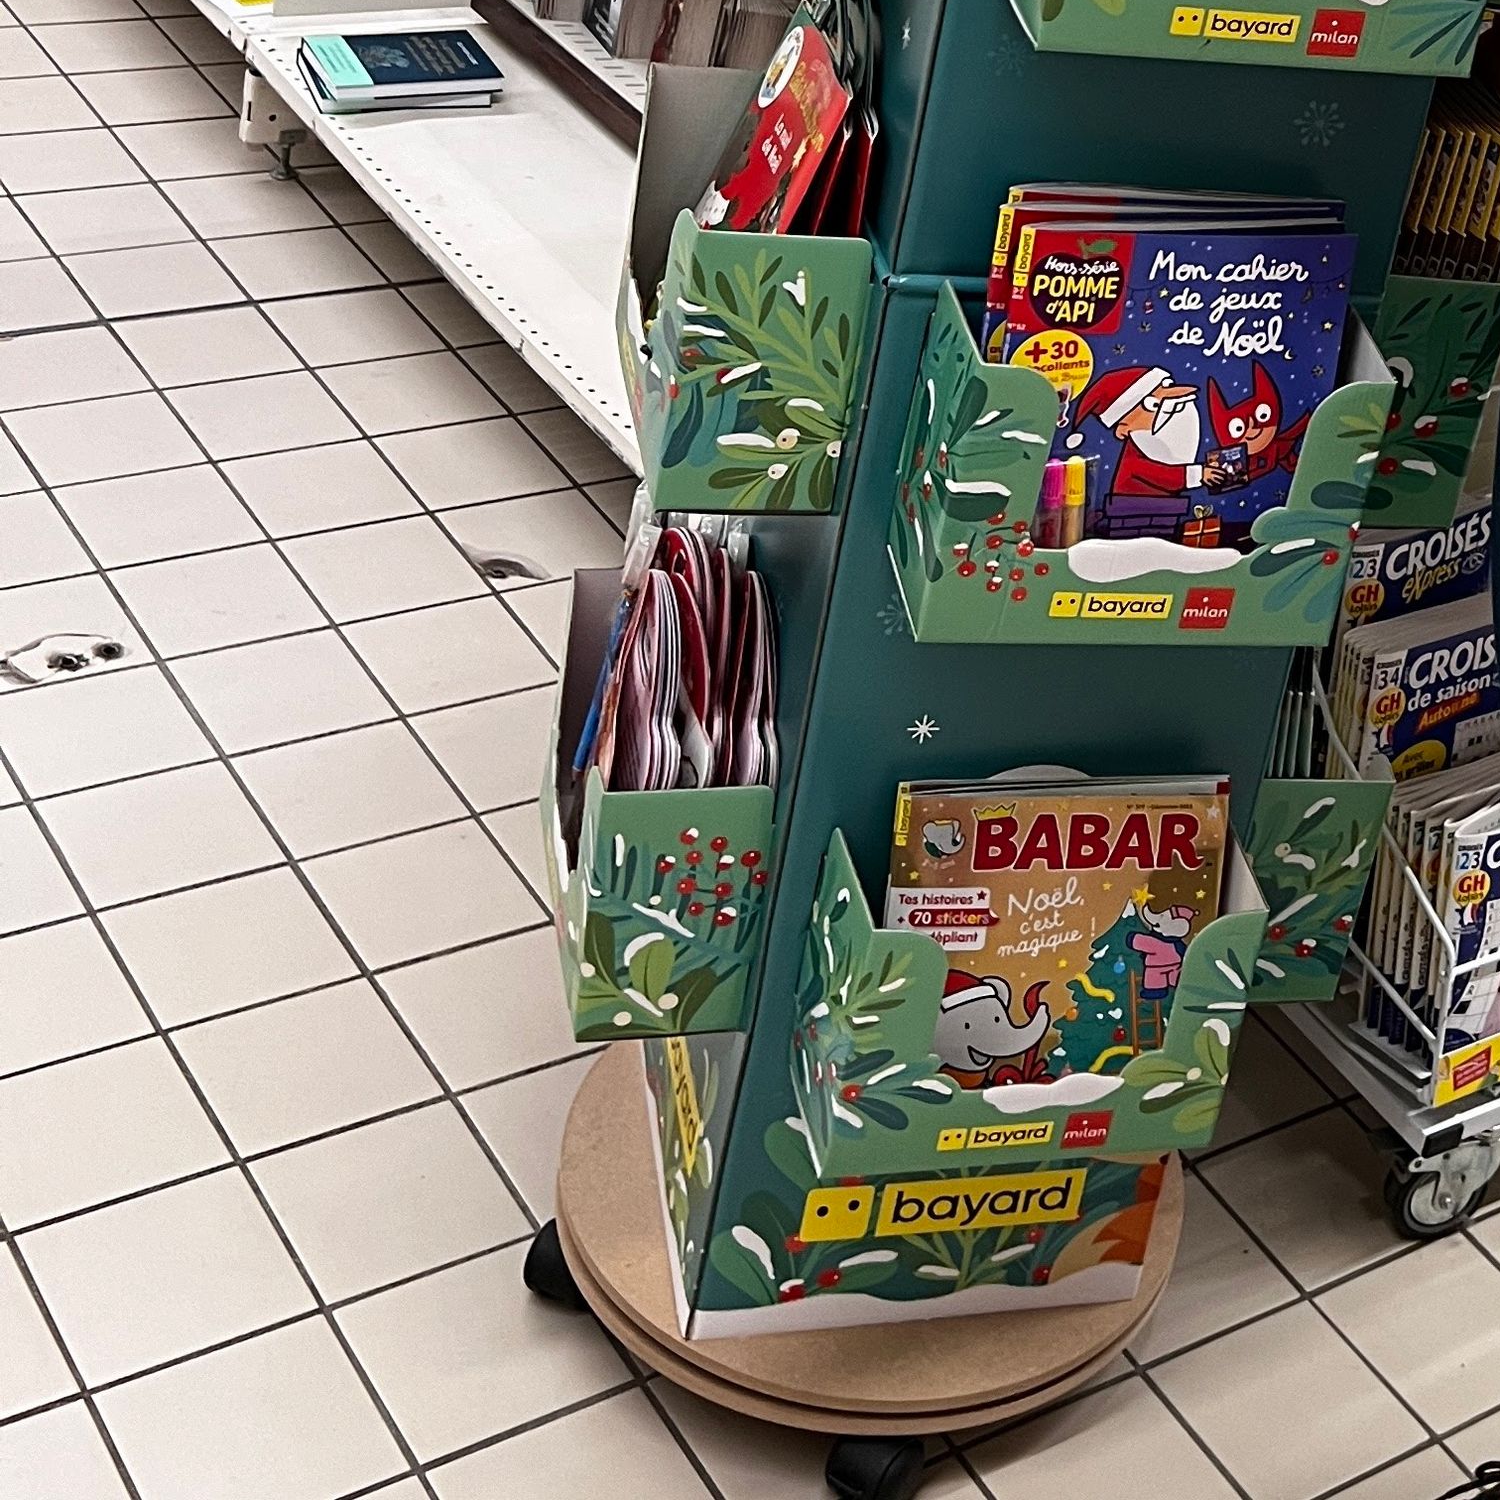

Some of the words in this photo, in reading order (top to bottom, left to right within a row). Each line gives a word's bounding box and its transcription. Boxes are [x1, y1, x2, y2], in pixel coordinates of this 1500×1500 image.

[1210, 14, 1294, 38] bayard
[1311, 21, 1358, 46] milan
[999, 213, 1012, 250] bayard
[1018, 233, 1032, 270] bayard
[1045, 255, 1120, 275] Hors-série
[1149, 250, 1212, 281] Mon
[1215, 253, 1309, 282] cahier
[1032, 275, 1120, 300] POMME
[1045, 300, 1096, 324] d'API
[1168, 287, 1204, 312] de
[1208, 288, 1283, 324] jeux
[1167, 320, 1205, 345] de
[1202, 315, 1285, 357] Noël
[1385, 510, 1492, 581] CROISÉS
[1087, 596, 1168, 616] bayard
[1351, 584, 1380, 604] GH
[1183, 596, 1228, 619] milan
[1408, 632, 1498, 689] CROIS
[1375, 693, 1403, 713] GH
[1407, 687, 1431, 713] de
[1436, 673, 1493, 703] saison
[971, 812, 1206, 872] BABAR
[1458, 875, 1486, 895] GH
[898, 893, 919, 905] Tes
[922, 893, 974, 906] histoires
[913, 911, 932, 925] 70
[934, 910, 989, 925] stickers
[1019, 911, 1065, 935] c'est
[997, 928, 1083, 958] magique
[972, 1125, 1049, 1145] bayard
[1064, 1119, 1108, 1143] milan
[890, 1179, 1076, 1228] bayard
